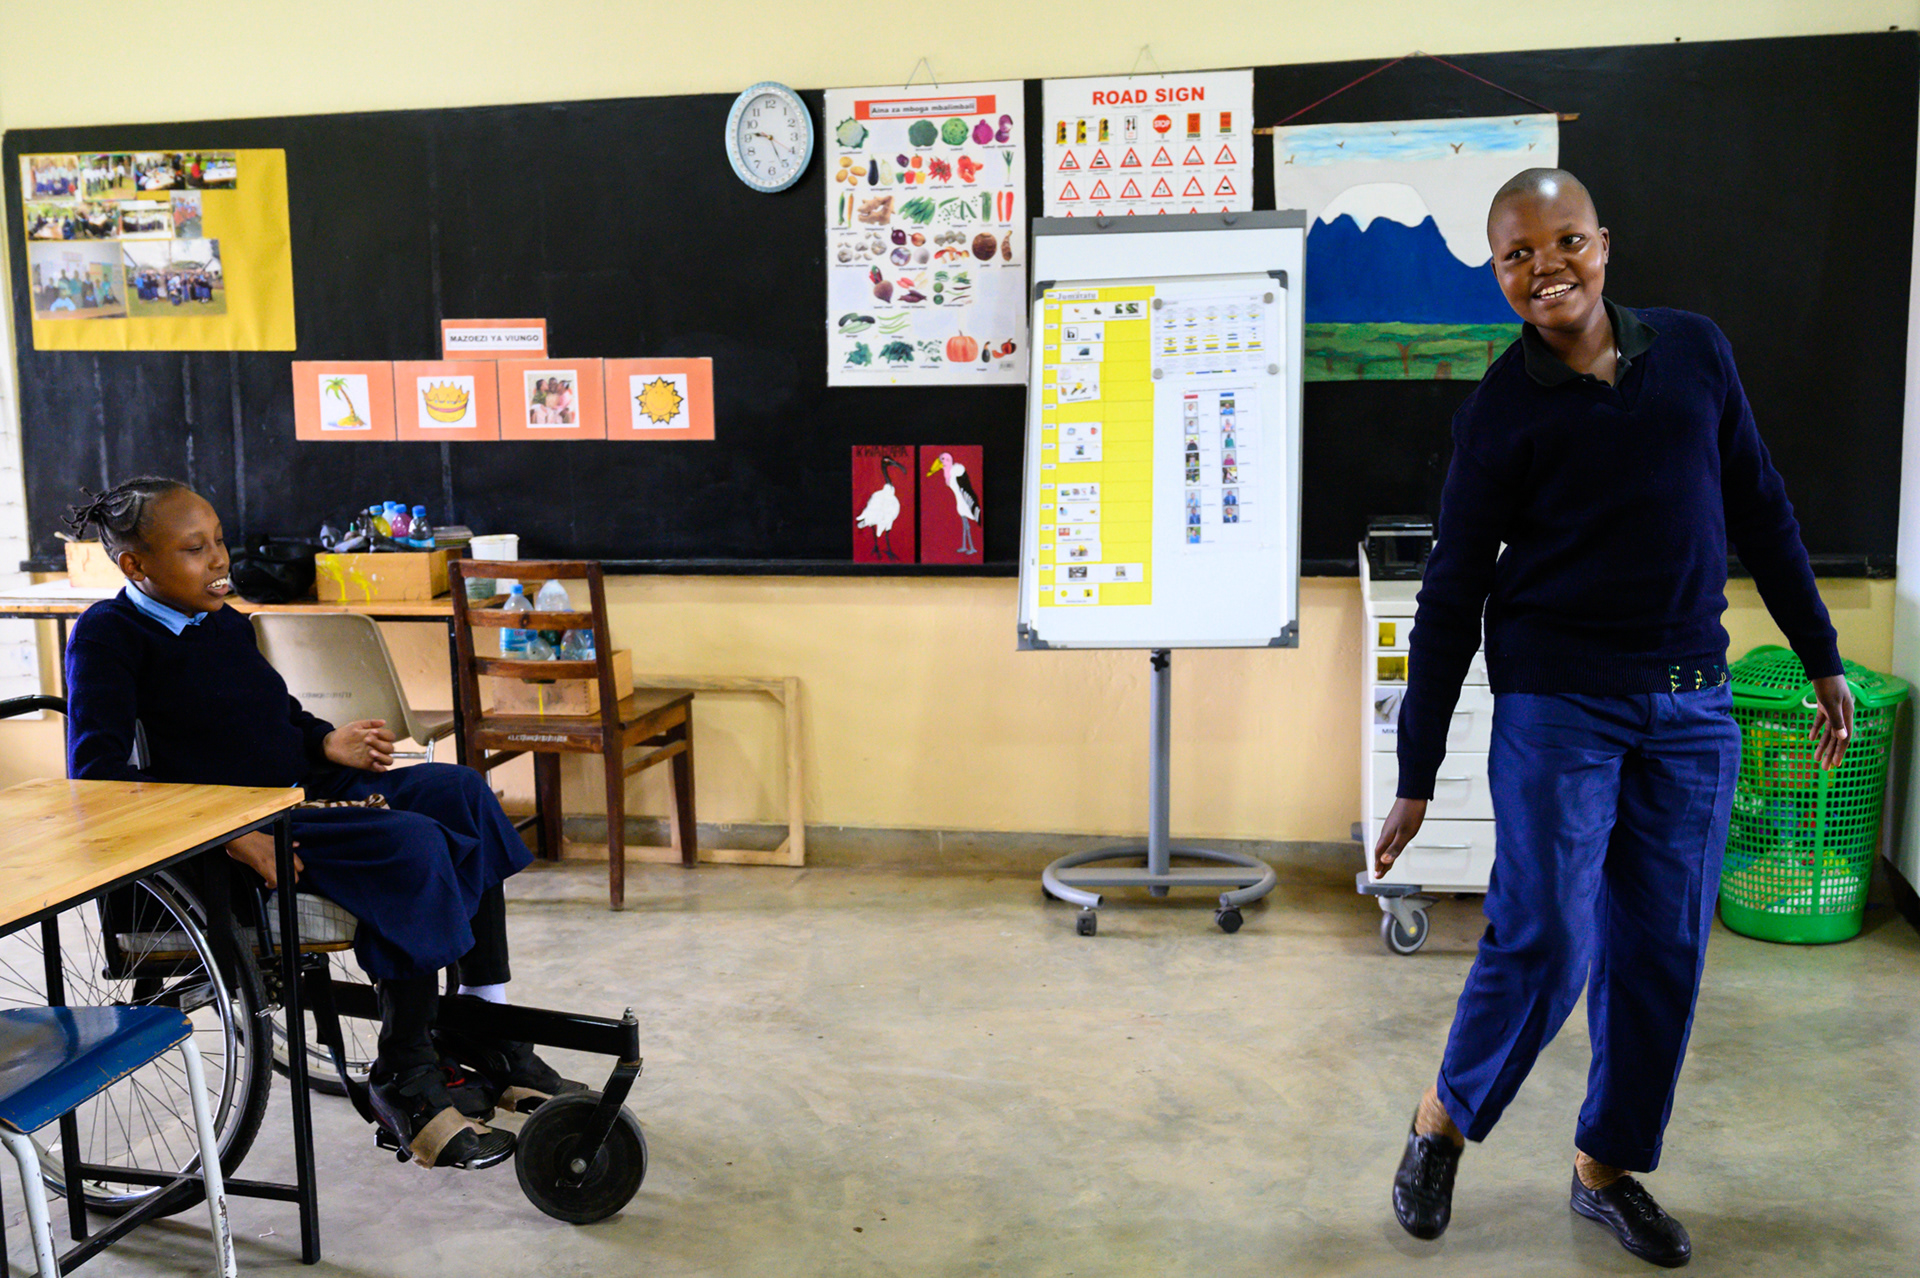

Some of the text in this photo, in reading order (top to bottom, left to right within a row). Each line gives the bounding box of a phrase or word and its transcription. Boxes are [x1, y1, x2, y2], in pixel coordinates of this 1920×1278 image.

[1092, 86, 1205, 106] ROAD SIGN
[765, 100, 776, 108] 12
[871, 106, 889, 114] Aina
[902, 104, 929, 113] mboga
[931, 102, 975, 112] mbalimbali
[752, 108, 760, 117] 11
[746, 119, 758, 129] 10
[788, 119, 796, 128] 2
[1153, 120, 1171, 129] STOP
[744, 134, 752, 142] 9
[790, 133, 798, 142] 3
[748, 147, 755, 156] 8
[790, 146, 796, 154] 4
[754, 160, 761, 168] 7
[781, 159, 789, 168] 5
[768, 166, 776, 176] 6
[505, 334, 539, 342] VIUNGO
